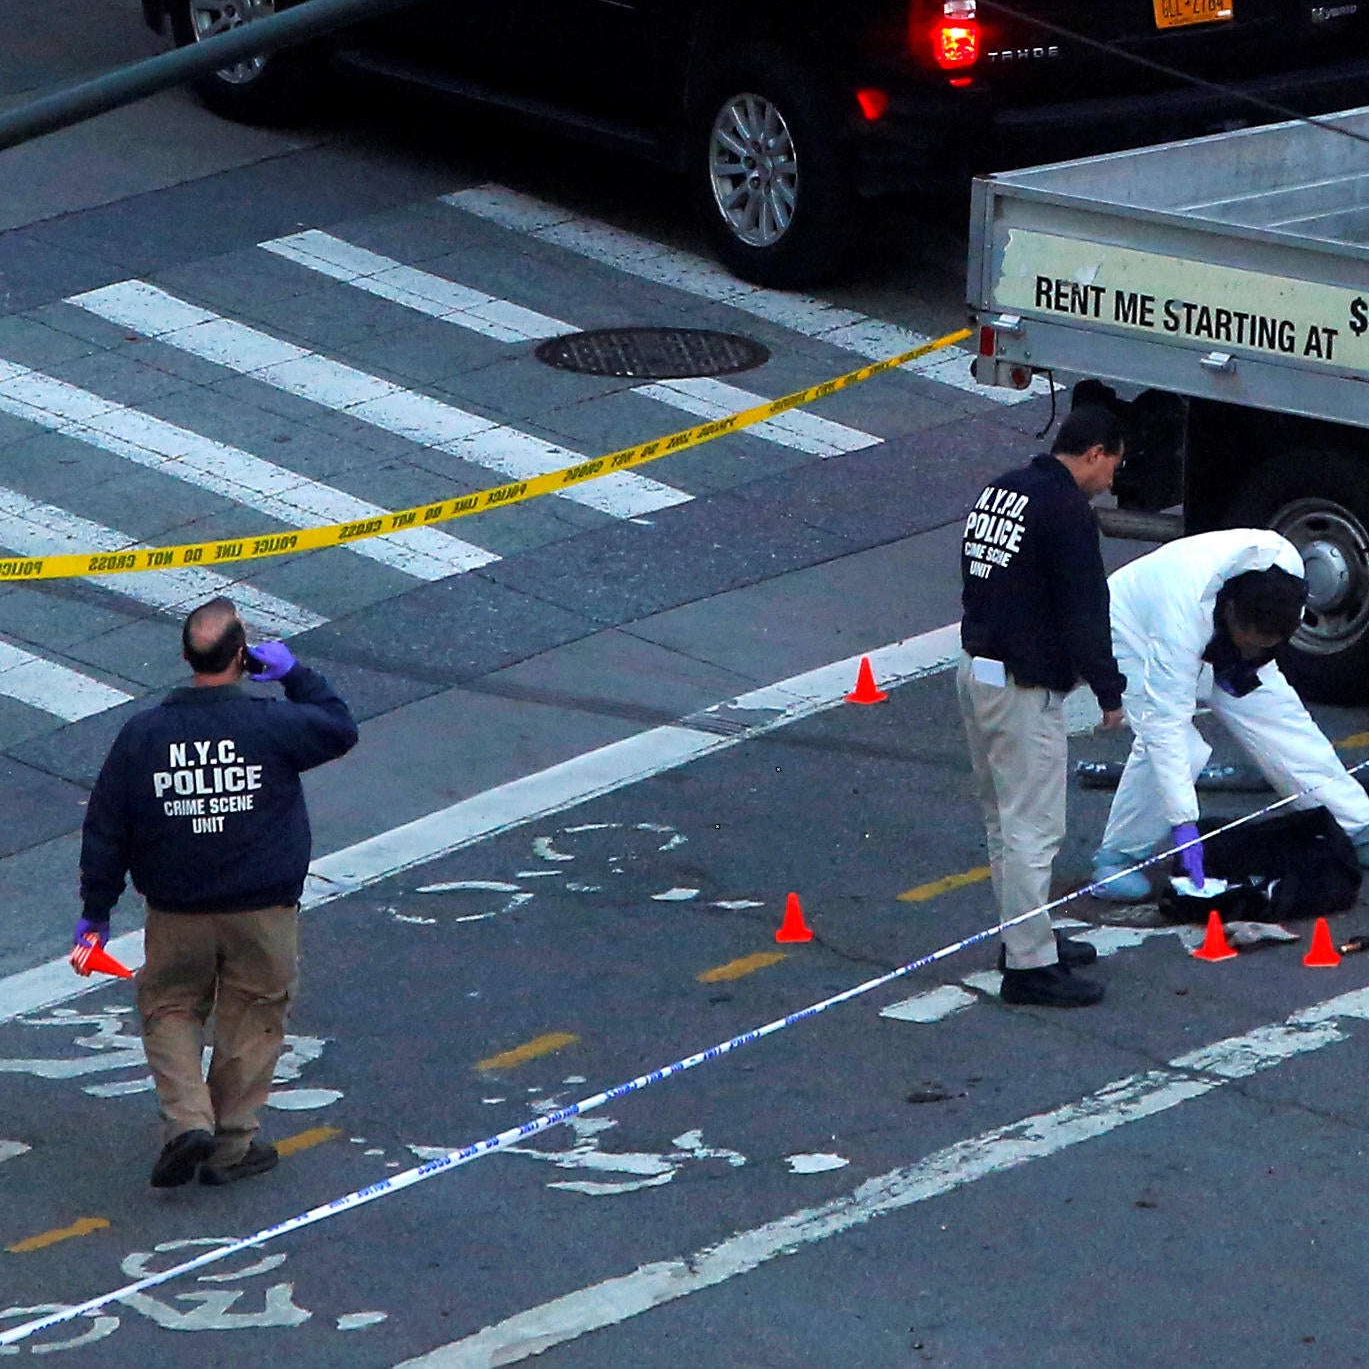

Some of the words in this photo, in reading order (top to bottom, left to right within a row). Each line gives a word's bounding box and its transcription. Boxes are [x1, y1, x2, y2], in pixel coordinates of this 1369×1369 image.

[987, 45, 1059, 63] TAHOE
[1035, 276, 1106, 318] RENT
[1113, 290, 1155, 328] ME
[1163, 299, 1295, 354] STARTING
[1303, 325, 1339, 360] AT
[963, 511, 1026, 553] POLICE
[969, 560, 993, 580] UNIT
[169, 739, 245, 768] N.Y.C.
[153, 765, 262, 798] POLICE
[163, 798, 206, 817] CRIME
[209, 794, 254, 814] SCENE
[192, 816, 225, 834] UNIT
